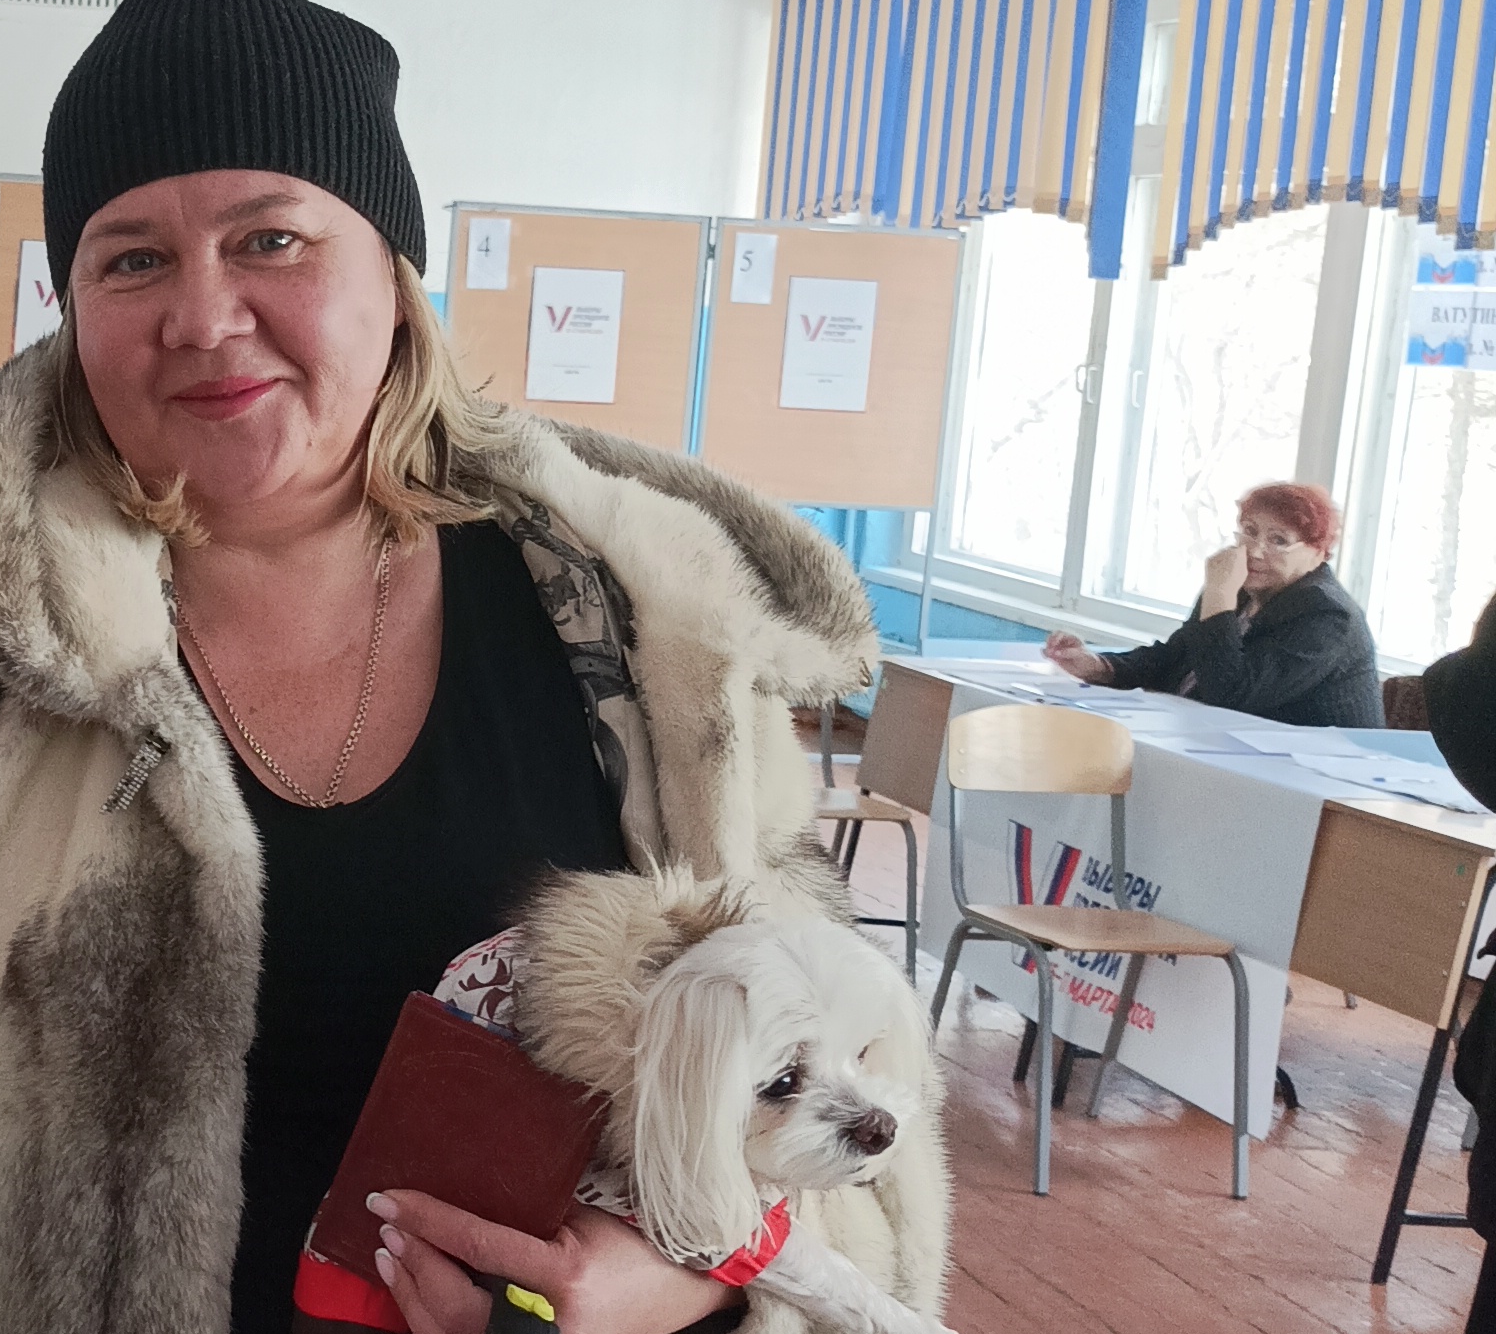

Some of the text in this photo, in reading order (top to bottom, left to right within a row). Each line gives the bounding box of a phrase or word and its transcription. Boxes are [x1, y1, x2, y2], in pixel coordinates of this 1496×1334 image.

[476, 235, 492, 257] 4
[739, 250, 754, 273] 5
[1127, 1001, 1156, 1034] 024
